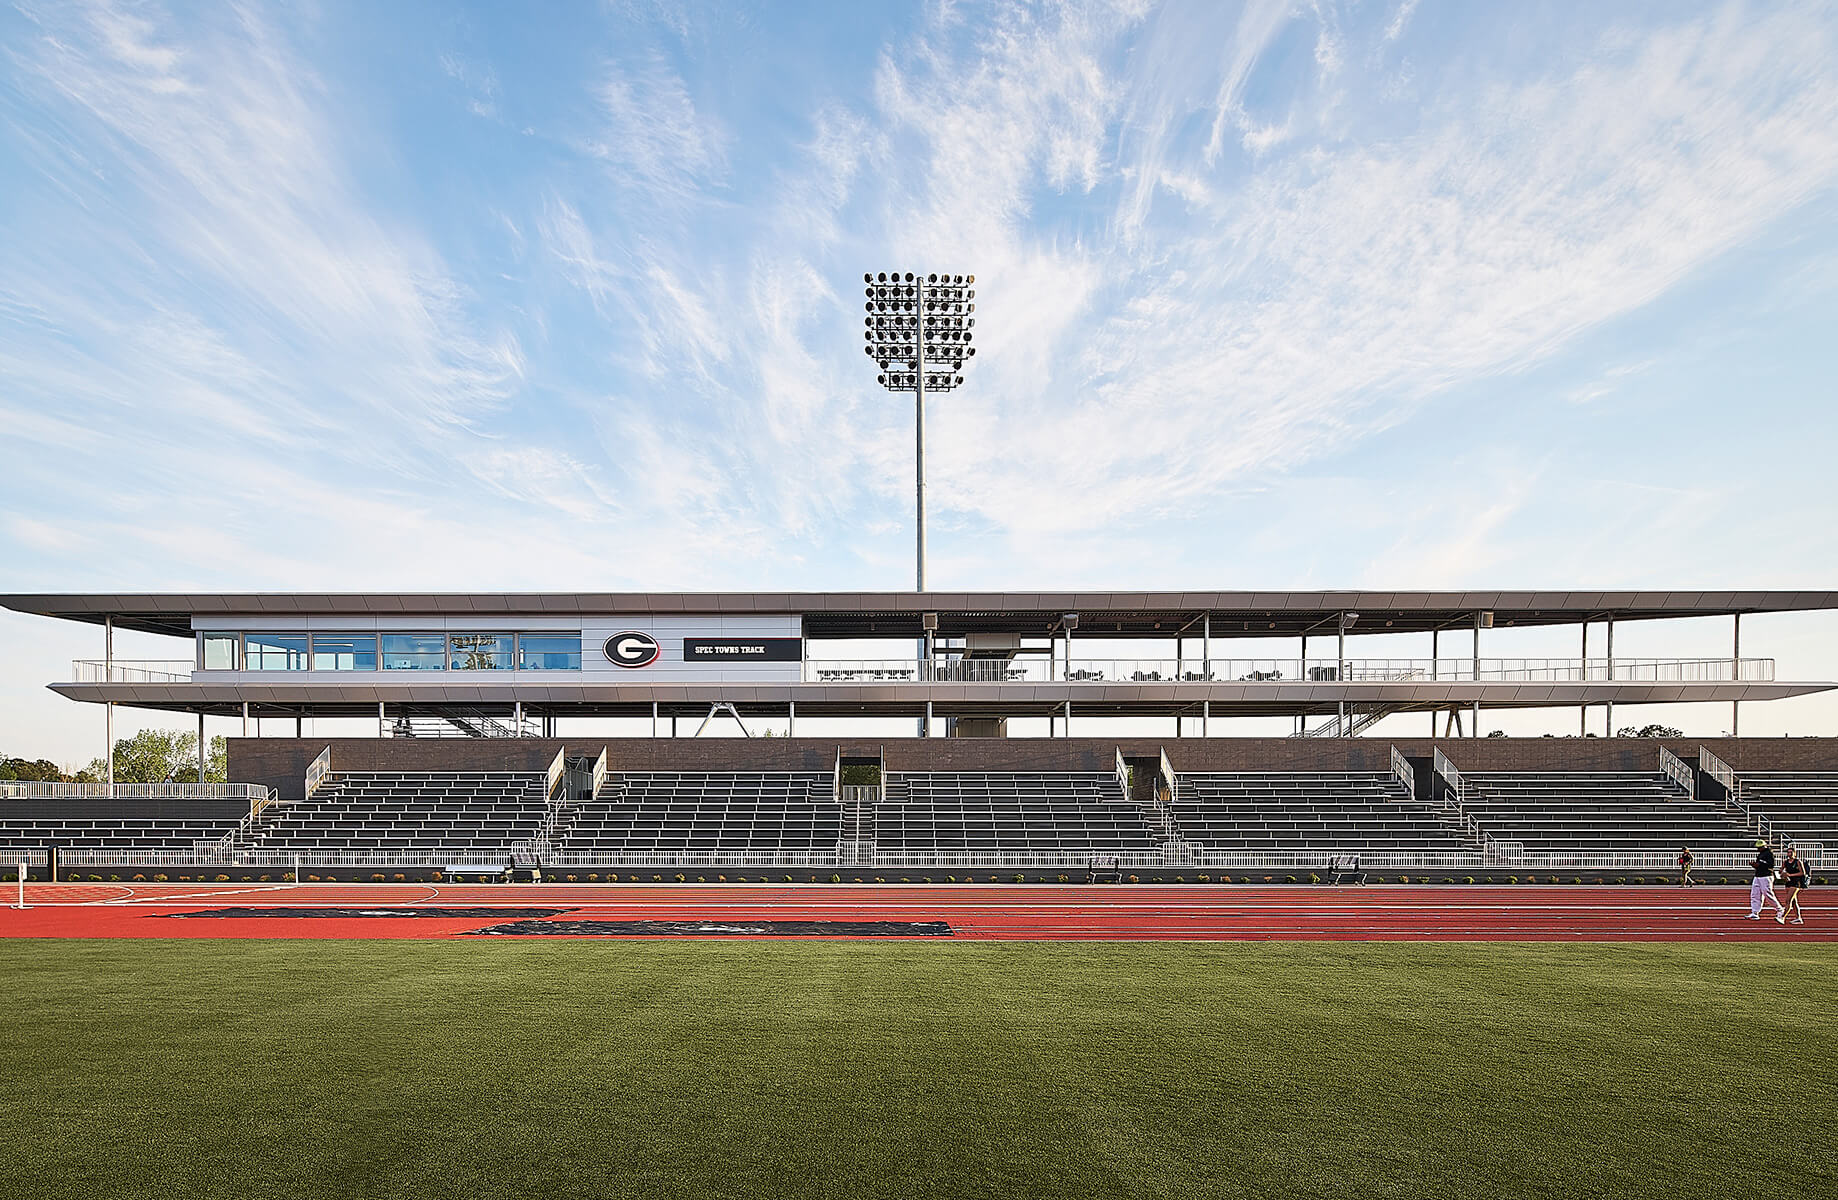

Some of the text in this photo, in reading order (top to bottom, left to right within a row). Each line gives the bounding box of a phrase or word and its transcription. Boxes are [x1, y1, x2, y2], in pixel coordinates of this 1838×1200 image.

[604, 632, 659, 667] G
[695, 646, 765, 654] SPEC TOWNS TRACK
